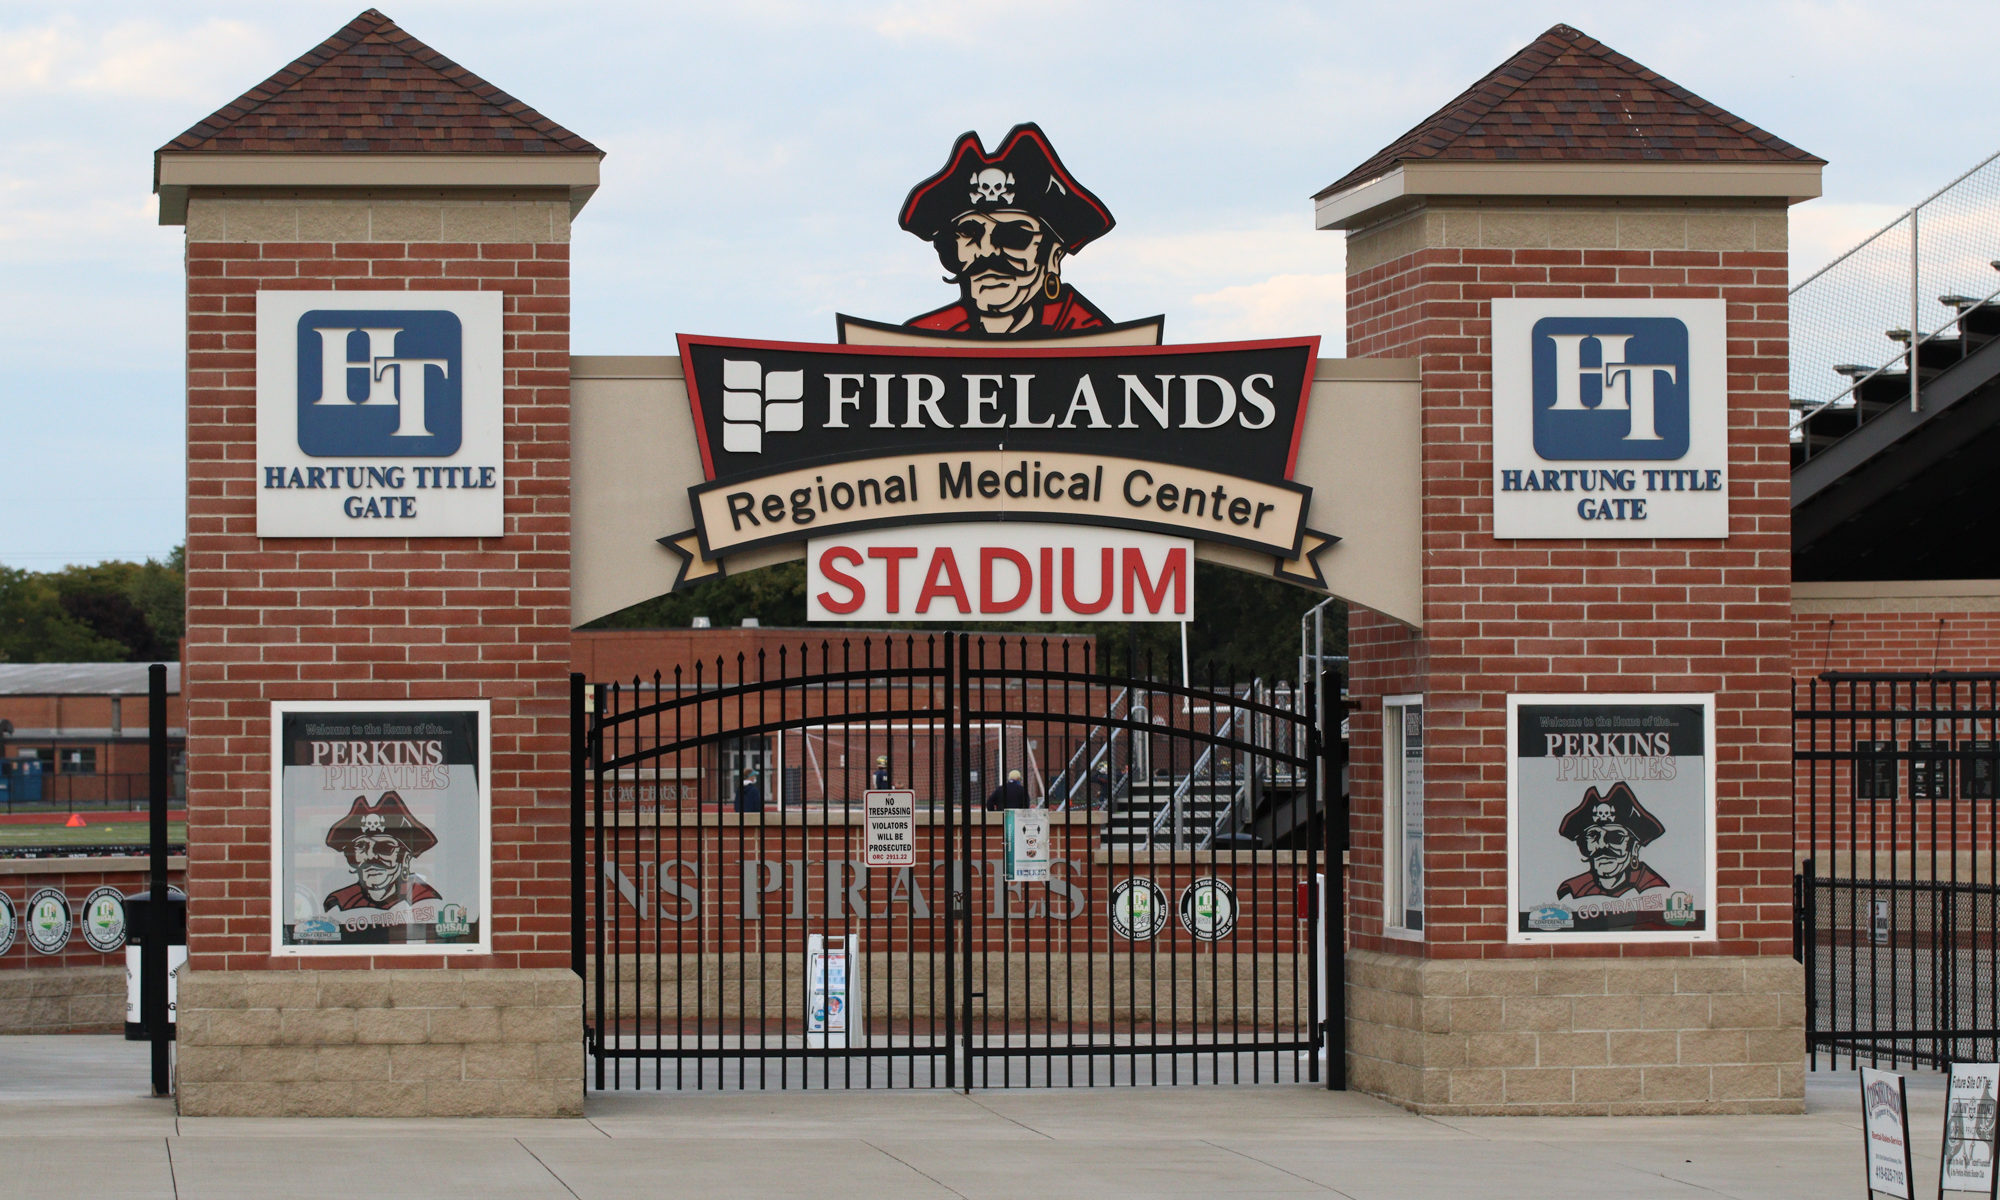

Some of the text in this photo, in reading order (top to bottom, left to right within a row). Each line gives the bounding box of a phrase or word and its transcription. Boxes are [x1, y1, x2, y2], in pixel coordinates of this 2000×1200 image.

[822, 372, 1276, 431] FIRELANDS
[264, 466, 496, 489] HARTUNG TITLE
[1501, 469, 1722, 491] HARTUNG TITLE
[726, 459, 1275, 531] Regional Medical Center
[343, 496, 417, 518] GATE
[1577, 498, 1647, 520] GATE
[816, 545, 1187, 614] STADIUM
[306, 723, 350, 736] Welcome
[352, 724, 363, 735] to
[364, 723, 381, 735] the
[383, 723, 412, 735] Home
[413, 723, 425, 735] of
[1540, 716, 1582, 728] Welcome
[1583, 717, 1594, 727] to
[1595, 716, 1612, 727] the
[1613, 716, 1641, 727] Home
[1641, 716, 1653, 727] of
[310, 739, 443, 766] PERKINS
[1544, 731, 1670, 758] PERKINS
[322, 764, 451, 790] PIRATES
[1556, 755, 1677, 781] PIRATES
[868, 807, 911, 816] TRESPASSING
[885, 798, 895, 806] NO
[872, 822, 908, 830] VIOLATORS
[877, 833, 904, 841] WILL BE
[869, 844, 912, 852] PROSECUTED
[1577, 903, 1601, 920] GO
[1602, 894, 1664, 916] PIRATES!
[1663, 910, 1697, 921] OHSAA
[345, 916, 369, 932] GO
[370, 906, 435, 929] PIRATES!
[435, 923, 471, 933] OHSAA
